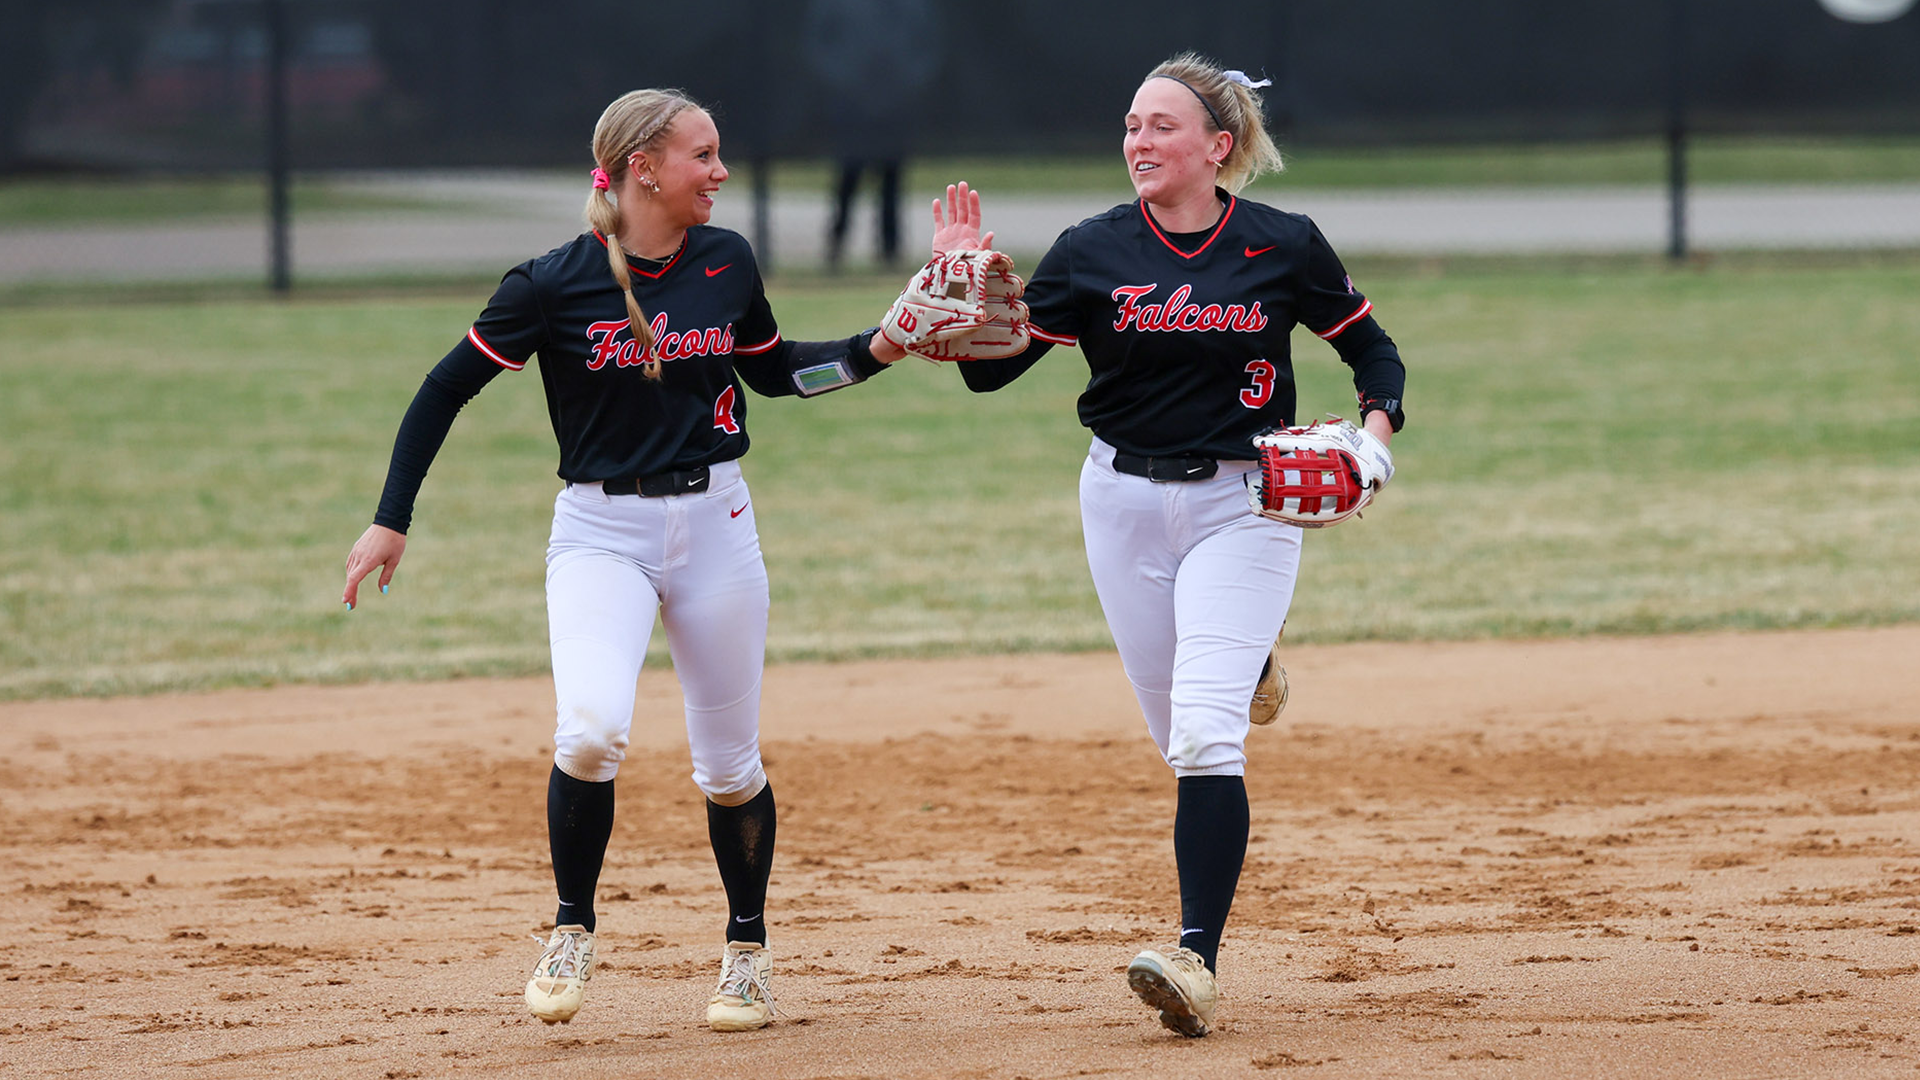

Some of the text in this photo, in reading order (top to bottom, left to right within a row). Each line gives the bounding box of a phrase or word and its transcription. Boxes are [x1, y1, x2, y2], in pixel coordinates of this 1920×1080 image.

[1111, 282, 1269, 333] Falcons
[585, 311, 735, 372] Falcons
[713, 384, 741, 435] 4
[1239, 358, 1277, 410] 3
